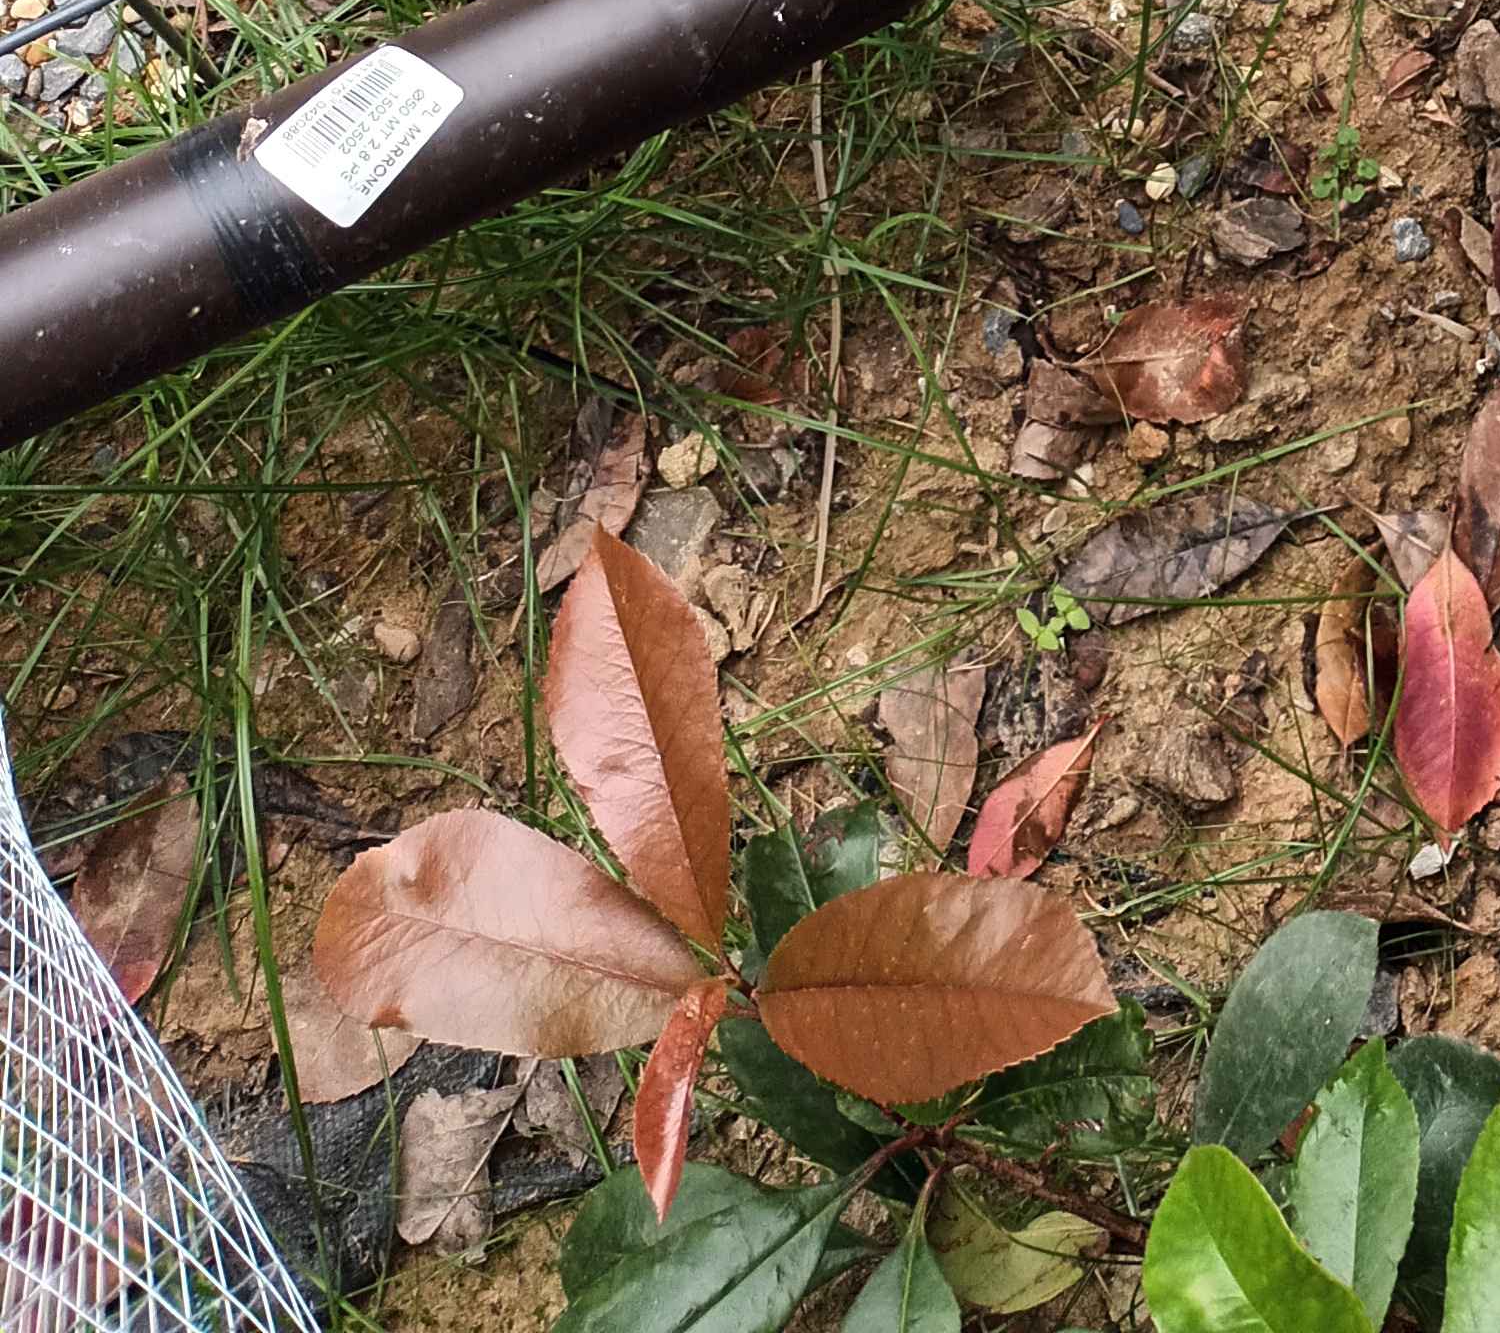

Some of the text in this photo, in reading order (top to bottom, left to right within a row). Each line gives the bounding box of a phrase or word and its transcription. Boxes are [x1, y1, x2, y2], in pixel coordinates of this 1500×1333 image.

[338, 90, 400, 155] 1502 2502
[378, 115, 402, 140] MT
[358, 100, 442, 196] PL MARRONE
[358, 137, 381, 161] 2.8
